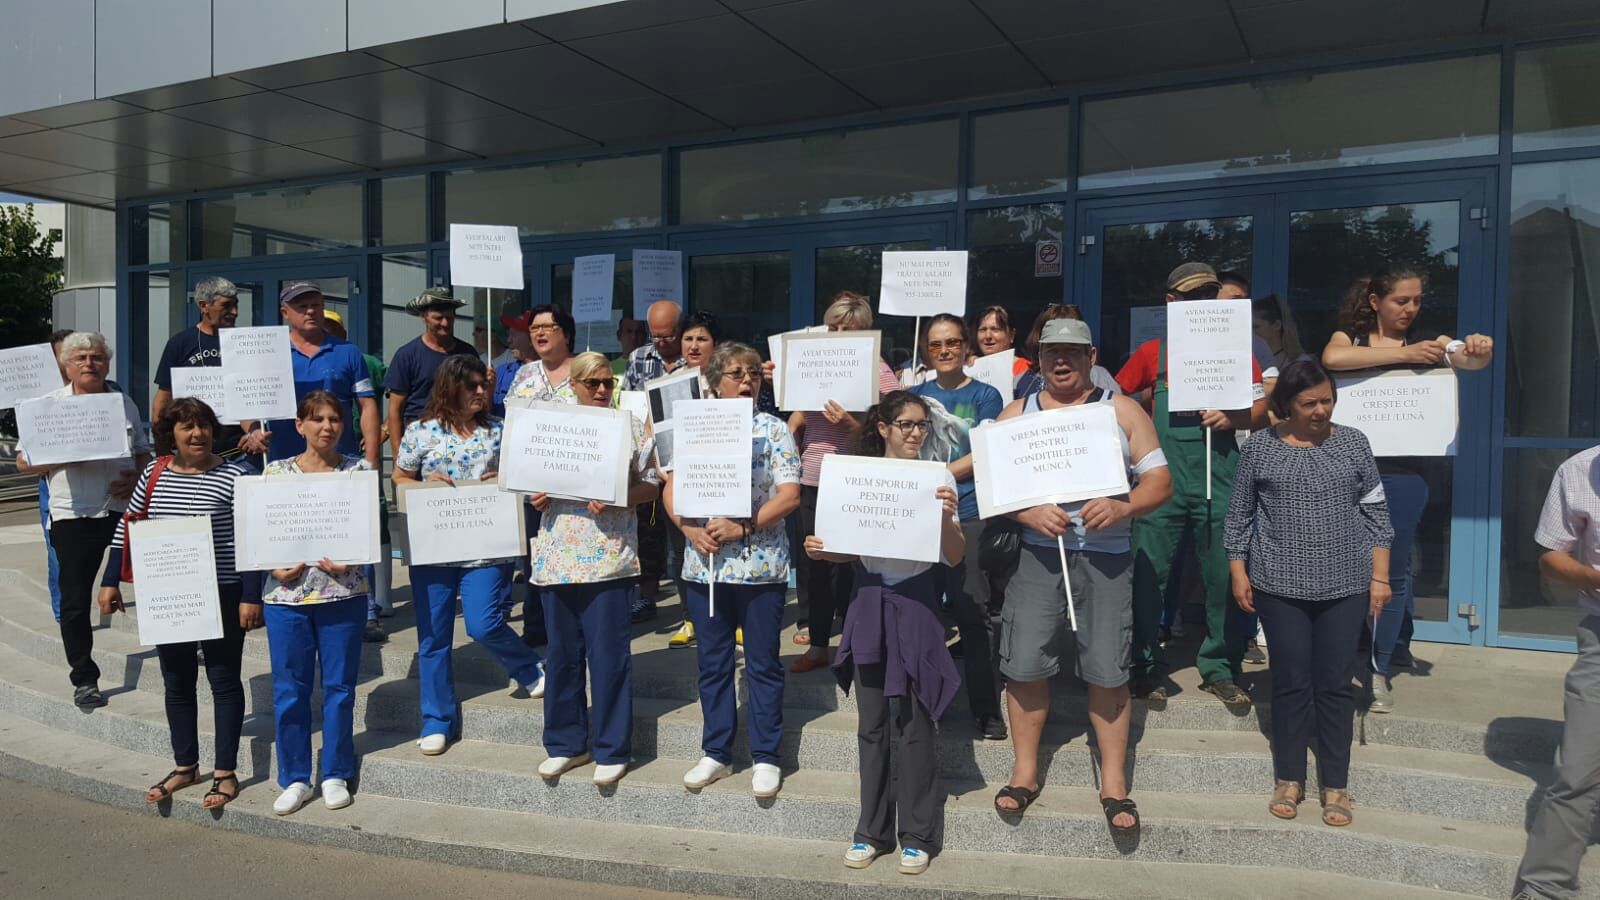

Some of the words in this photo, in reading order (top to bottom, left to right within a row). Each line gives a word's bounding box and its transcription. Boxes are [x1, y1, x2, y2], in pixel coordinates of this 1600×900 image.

[802, 350, 823, 358] AVEM
[823, 348, 857, 357] VENITURI
[797, 360, 824, 369] PROPRII
[825, 359, 839, 368] MAI
[840, 359, 859, 368] MARI
[1183, 359, 1204, 367] VREM
[835, 370, 854, 378] ANUL
[1350, 389, 1377, 398] COPII
[1379, 389, 1394, 397] NU
[1396, 388, 1409, 396] SE
[1411, 387, 1431, 396] POT
[1363, 400, 1401, 410] CREȘTE
[1403, 399, 1419, 408] CU
[1356, 414, 1373, 422] 955
[1374, 413, 1391, 422] LEI
[536, 423, 561, 434] VREM
[562, 425, 599, 437] SALARII
[1011, 428, 1040, 442] VREM
[1041, 421, 1086, 436] SPORURI
[531, 435, 572, 447] DECENTE
[585, 441, 600, 450] NE
[1028, 436, 1069, 450] PENTRU
[525, 447, 556, 458] PUTEM
[1074, 446, 1089, 456] DE
[543, 460, 581, 473] FAMILIA
[688, 463, 708, 471] VREM
[709, 463, 736, 471] SALARII
[687, 472, 718, 480] DECENTE
[845, 476, 873, 487] VREM
[875, 478, 919, 490] SPORURI
[426, 498, 452, 508] COPII
[453, 497, 467, 506] NU
[468, 496, 479, 504] SE
[480, 495, 498, 503] POT
[860, 491, 900, 503] PENTRU
[474, 507, 488, 516] CU
[901, 508, 916, 519] DE
[450, 521, 465, 529] LEI
[858, 518, 896, 531] MUNCĂ
[151, 595, 170, 603] AVEM
[170, 592, 201, 601] VENITURI
[148, 604, 173, 612] PROPRII
[174, 602, 187, 610] MAI
[187, 601, 207, 609] MARI
